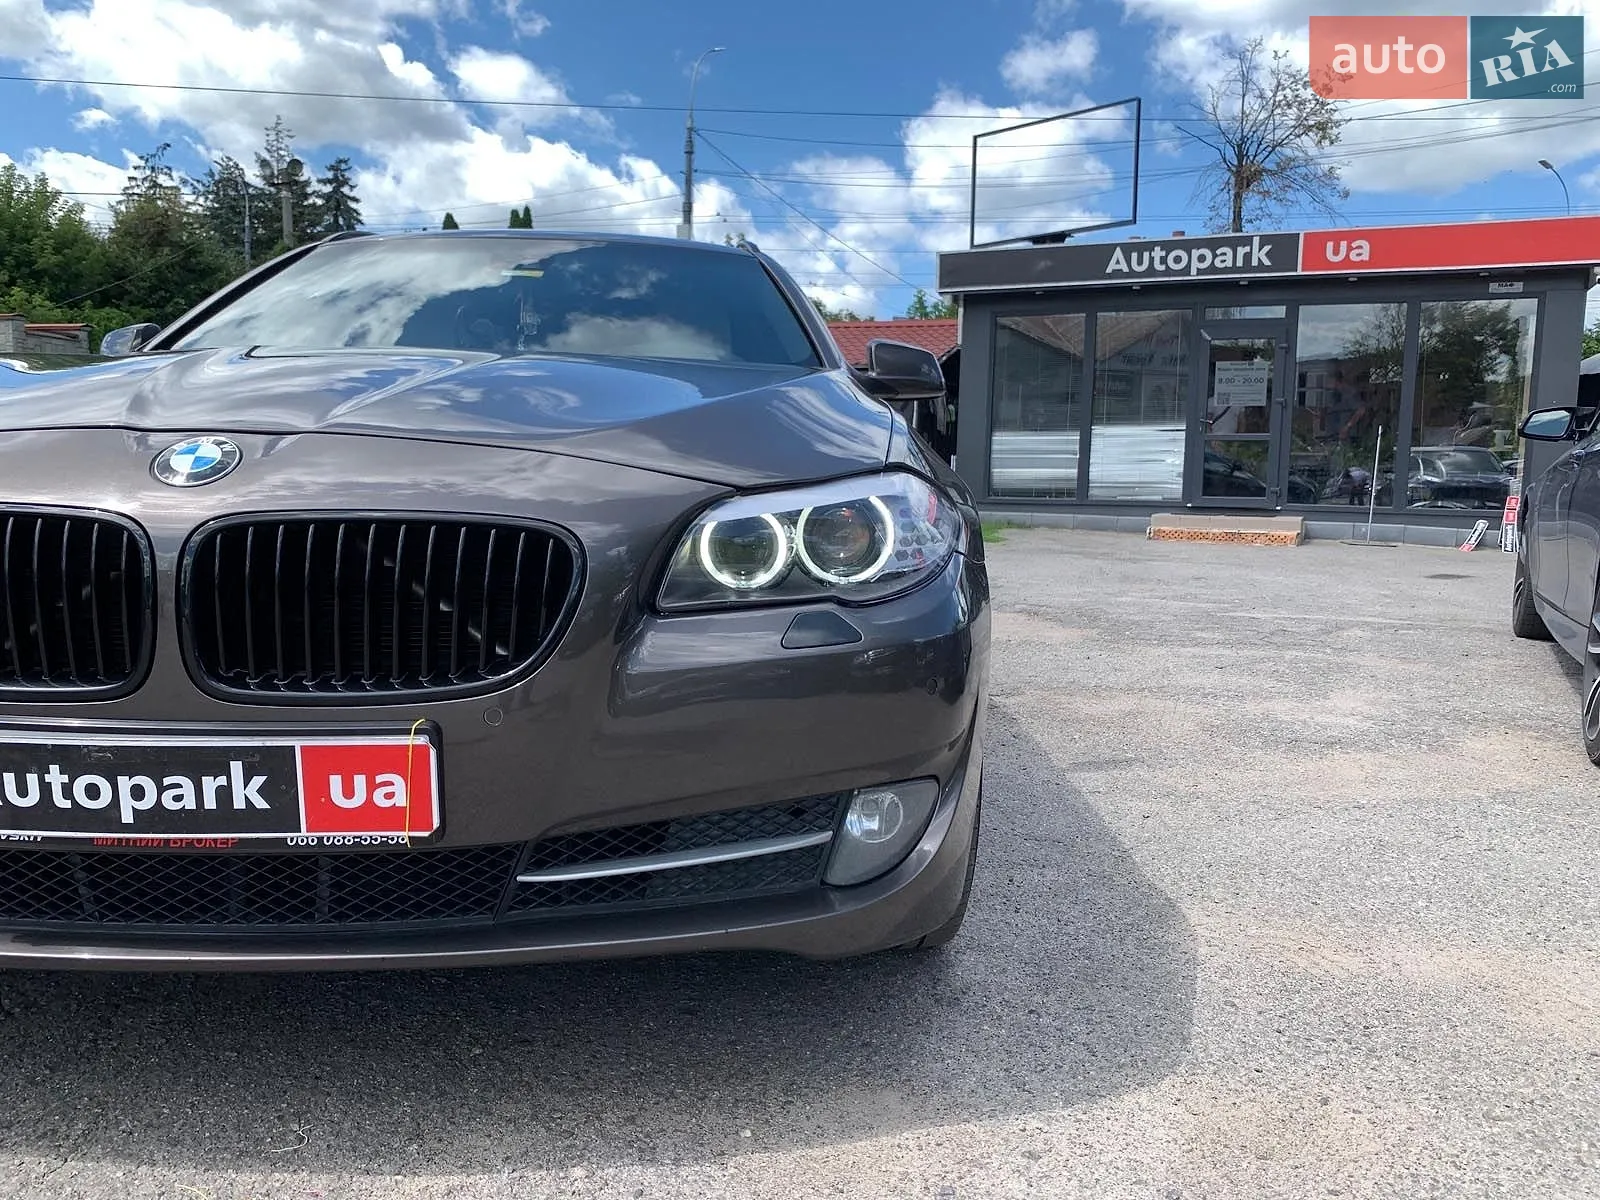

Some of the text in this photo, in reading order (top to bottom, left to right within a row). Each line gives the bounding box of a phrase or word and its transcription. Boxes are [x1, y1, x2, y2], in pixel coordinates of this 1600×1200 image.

[1105, 236, 1371, 276] Autopark ua
[0, 760, 407, 824] utopark ua
